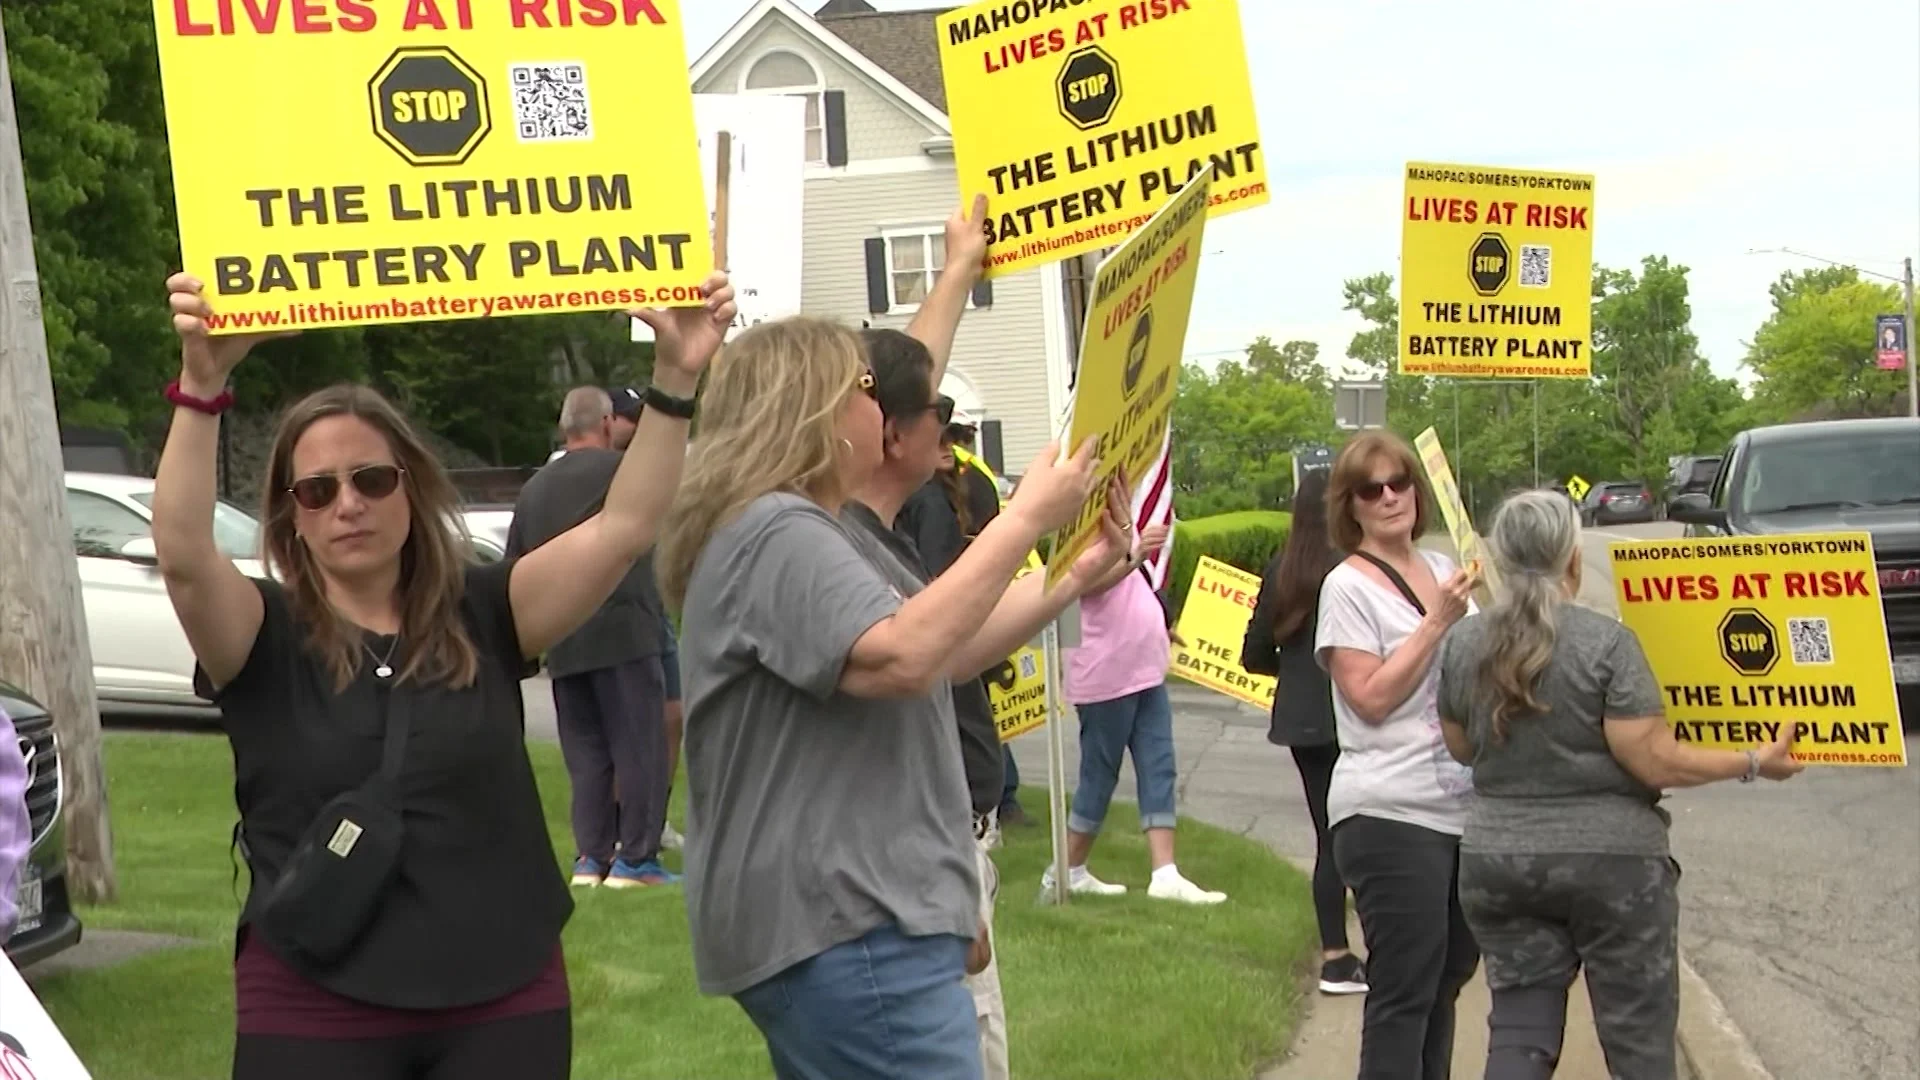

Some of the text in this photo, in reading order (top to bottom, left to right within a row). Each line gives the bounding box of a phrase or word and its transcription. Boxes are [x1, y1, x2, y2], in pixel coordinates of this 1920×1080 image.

[176, 0, 377, 36] LIVES
[403, 0, 474, 31] AT
[983, 28, 1065, 73] LIVES
[1075, 13, 1109, 46] AT
[1068, 73, 1109, 104] STOP
[392, 90, 467, 122] STOP
[988, 104, 1217, 195] THE LITHIUM
[1408, 167, 1591, 191] MAHOPAC/SOMERS/YORKTOWN
[246, 174, 632, 227] THE LITHIUM
[983, 179, 1126, 246] BATTERY
[1408, 196, 1588, 230] LIVES AT RISK
[215, 233, 691, 295] BATTERY PLANT
[1475, 256, 1504, 273] STOP
[1103, 284, 1142, 340] LIVES
[1143, 266, 1161, 302] AT
[1423, 302, 1561, 326] THE LITHIUM
[1409, 335, 1582, 359] BATTERY PLANT
[1614, 540, 1866, 561] MAHOPAC/SOMERS/YORKTOWN
[1198, 576, 1259, 609] LIVES
[1621, 575, 1719, 603] LIVES
[1732, 572, 1771, 599] AT
[1784, 570, 1870, 598] RISK
[1196, 637, 1233, 661] THE
[1729, 633, 1768, 652] STOP
[1176, 653, 1261, 692] BATTERY
[1664, 685, 1856, 707] THE LITHIUM
[1674, 721, 1889, 744] ATTERY PLANT
